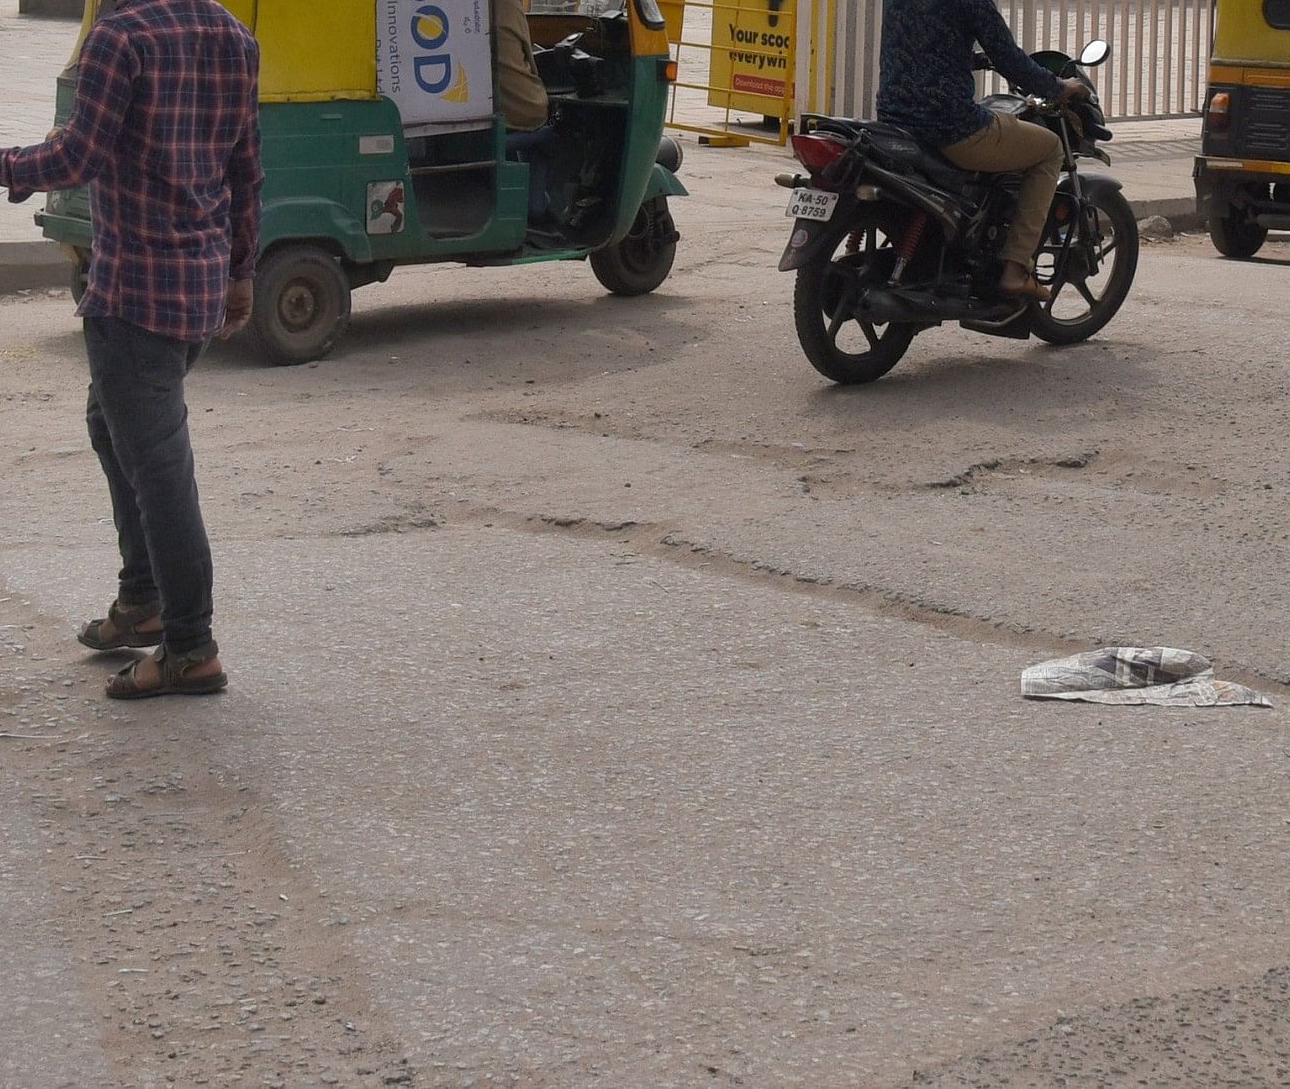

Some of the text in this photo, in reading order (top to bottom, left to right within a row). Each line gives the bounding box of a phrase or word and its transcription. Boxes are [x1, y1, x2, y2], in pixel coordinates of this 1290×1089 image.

[729, 23, 758, 44] Your
[387, 0, 401, 93] Innovations
[798, 192, 828, 206] KA-50
